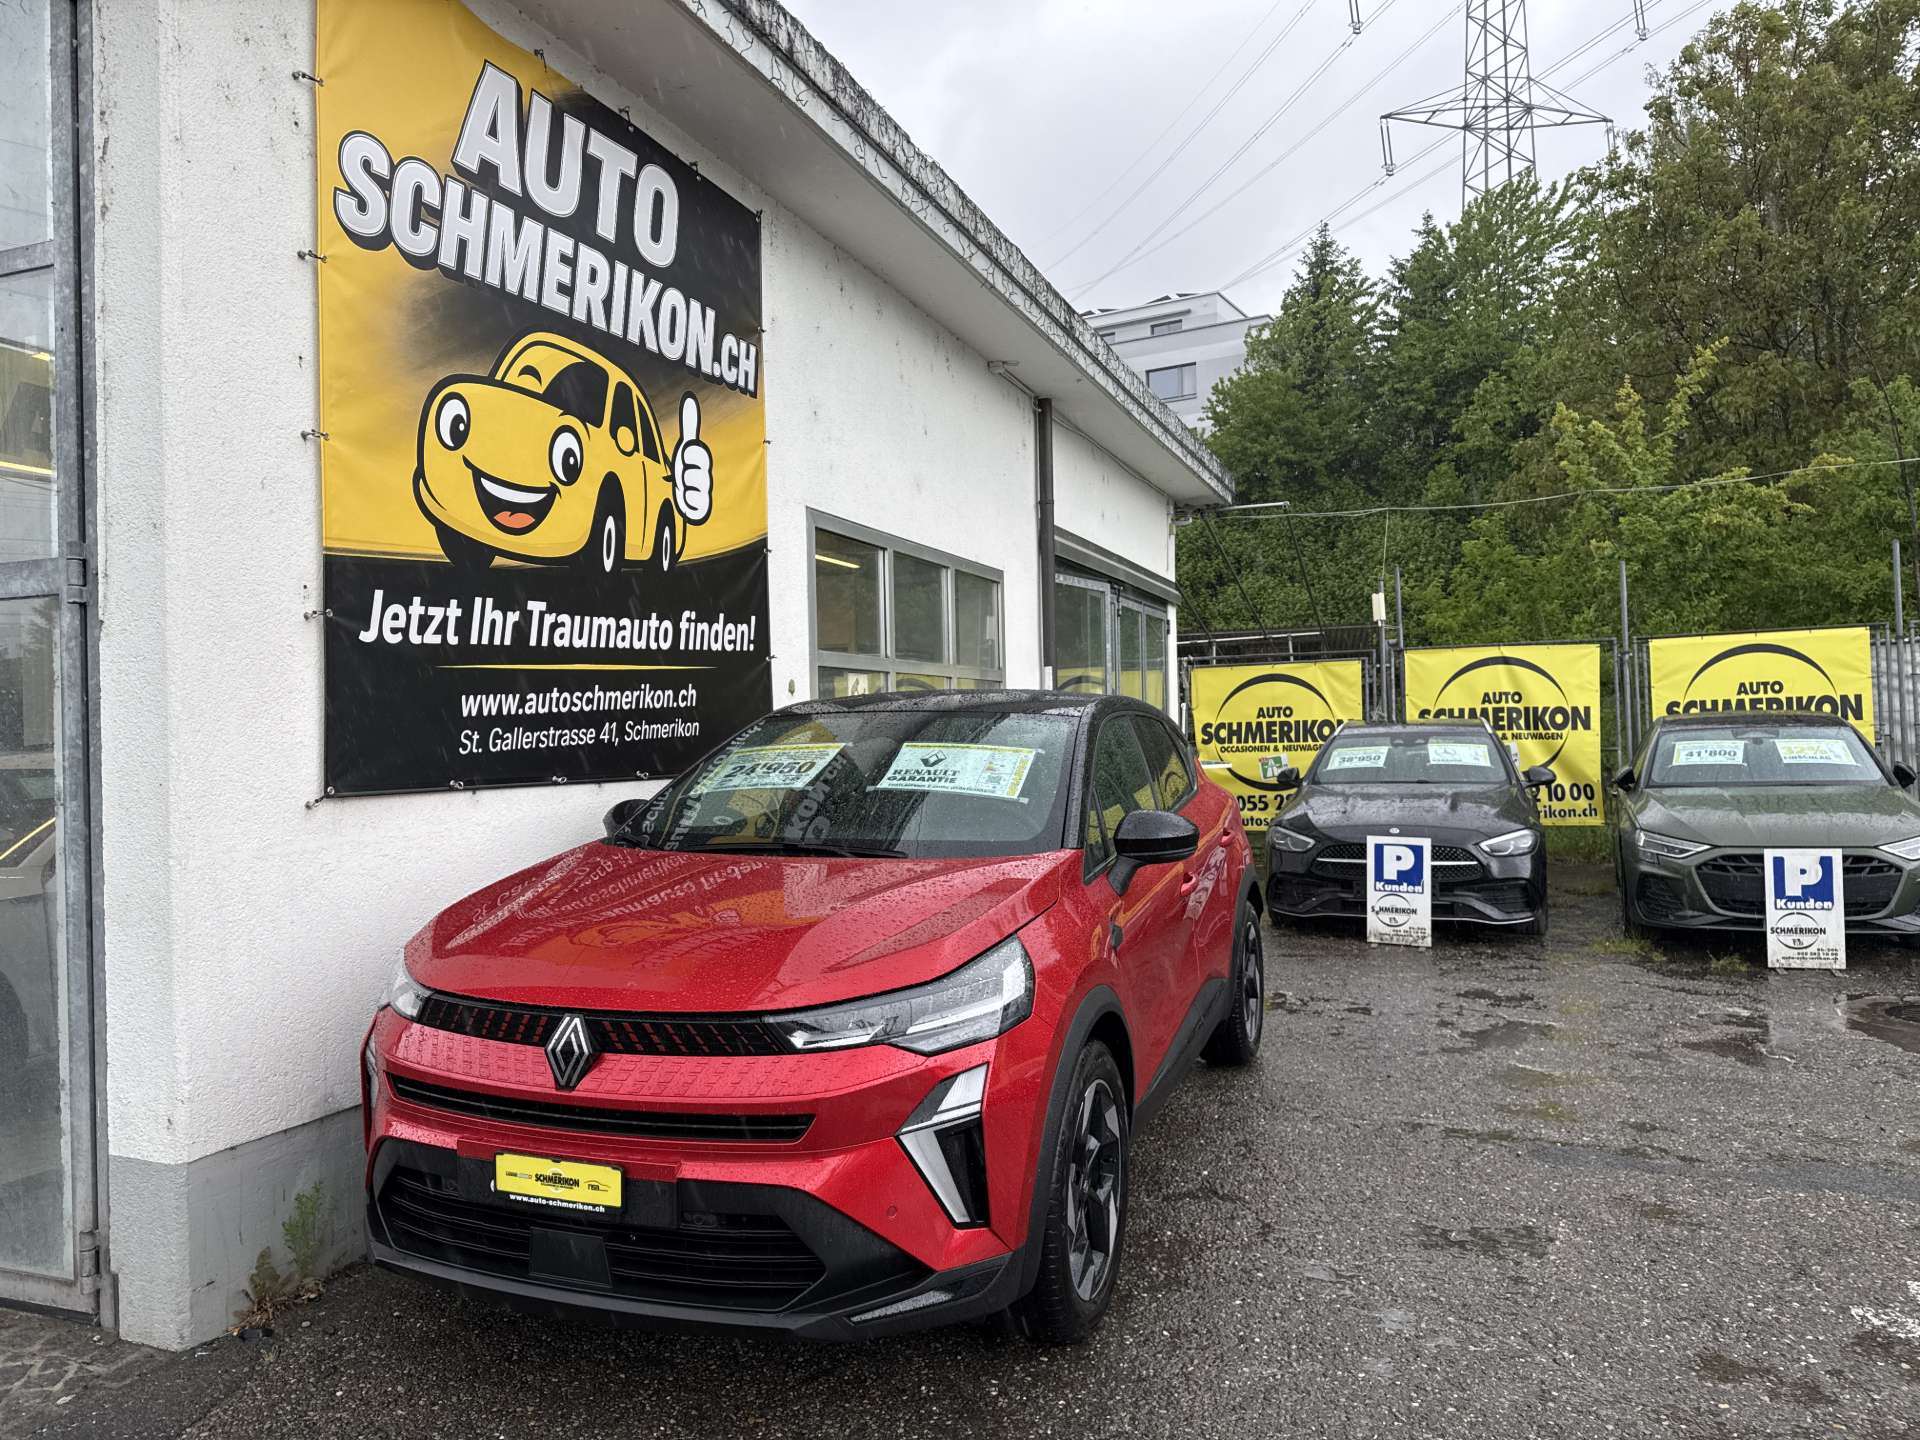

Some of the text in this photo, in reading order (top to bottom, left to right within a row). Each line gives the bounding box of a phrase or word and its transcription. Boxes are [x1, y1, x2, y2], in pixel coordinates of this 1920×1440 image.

[454, 61, 679, 268] AUTO
[335, 132, 757, 394] SCHMERIKON.CH
[358, 589, 757, 652] Jetzt Ihr Traumauto finden!
[1736, 680, 1784, 695] AUTO
[460, 683, 698, 718] www.autoschmerikon.ch
[1481, 691, 1523, 705] AUTO
[1256, 706, 1294, 719] AUTO
[458, 717, 700, 755] St. Gallerstrasse 41, Schmerikon
[1200, 718, 1344, 746] SCHMERIKO
[1500, 731, 1564, 741] & NEUWAGEN
[1220, 745, 1271, 754] OCCASIONEN
[1273, 744, 1280, 752] &
[887, 775, 958, 784] GARANTIE
[891, 768, 961, 777] RENAULT
[1569, 782, 1595, 801] 00
[1236, 794, 1269, 812] 055
[1383, 845, 1415, 880] P
[1783, 856, 1823, 896] P
[1375, 881, 1423, 893] Kunden
[1776, 898, 1833, 910] Kunden
[1770, 926, 1827, 935] SCHMERIKON
[534, 1172, 580, 1188] SCHMERIKON
[509, 1193, 606, 1213] www.auto-schmerikon.ch
